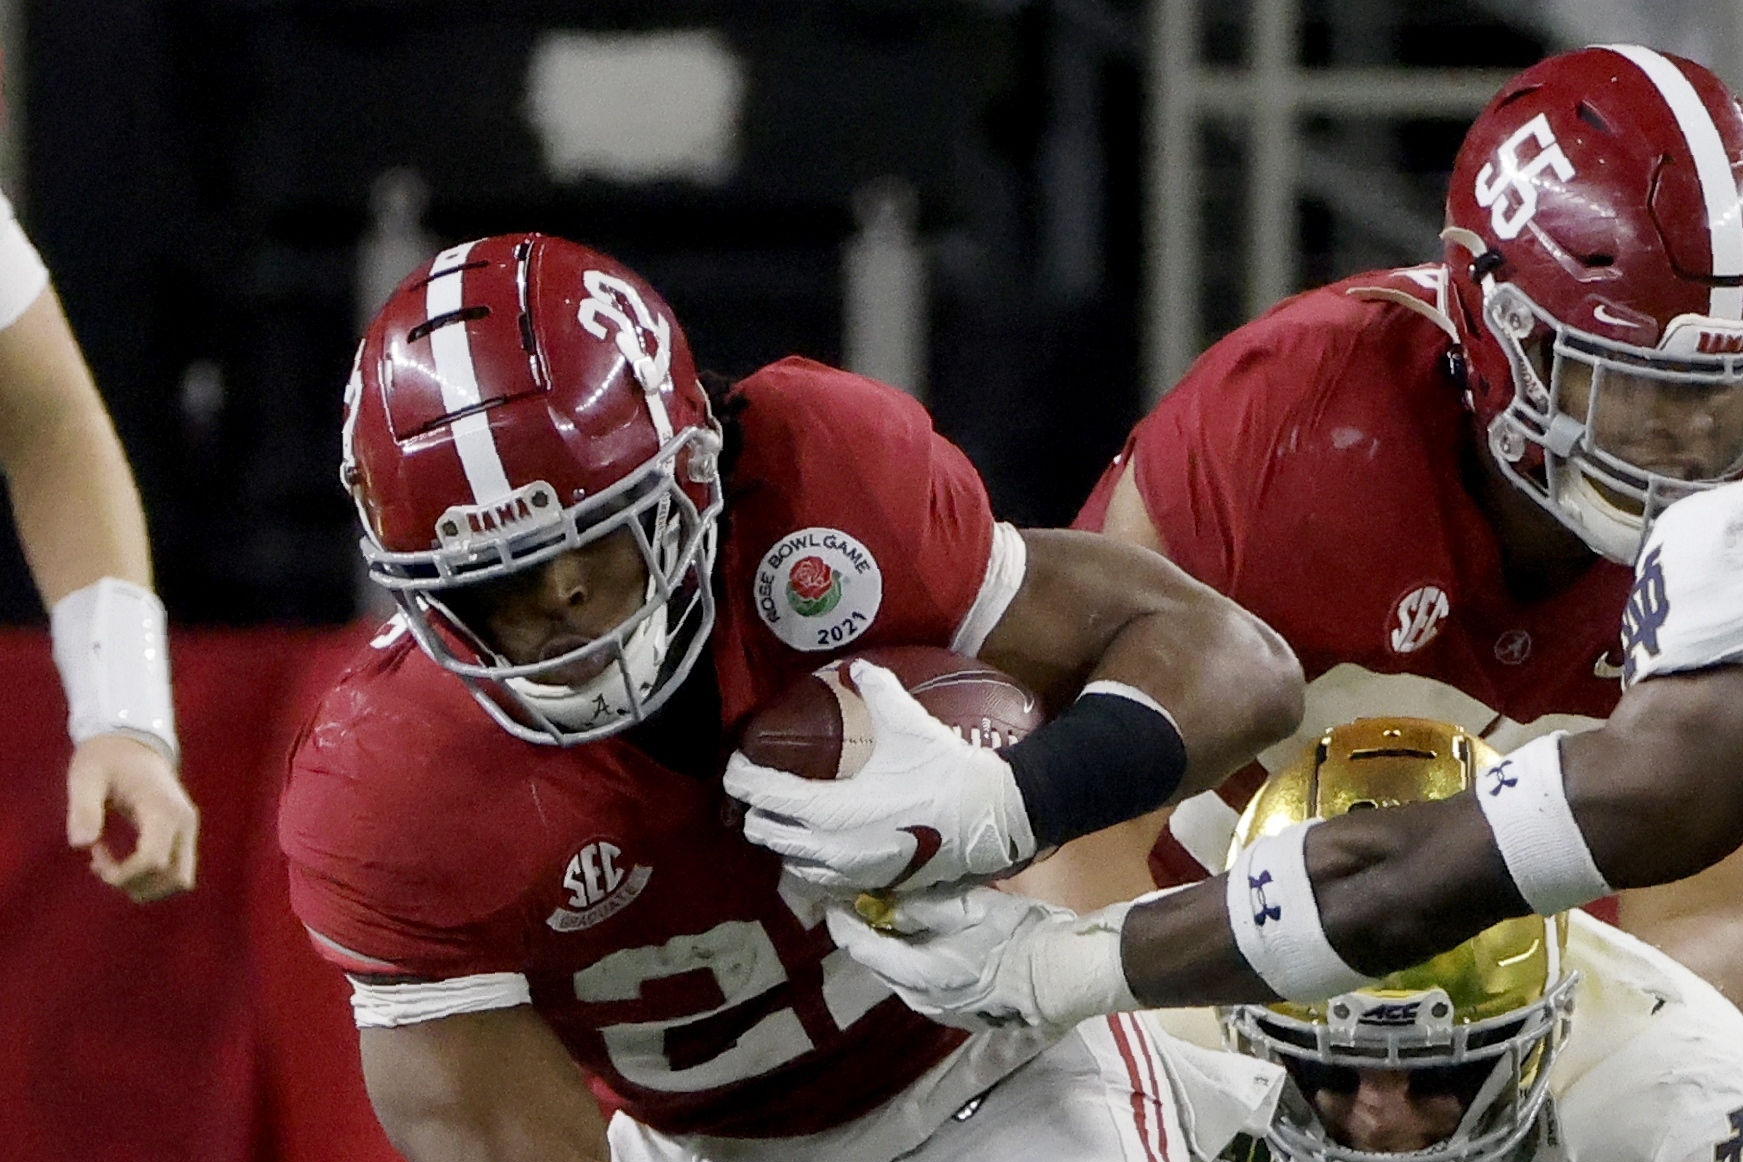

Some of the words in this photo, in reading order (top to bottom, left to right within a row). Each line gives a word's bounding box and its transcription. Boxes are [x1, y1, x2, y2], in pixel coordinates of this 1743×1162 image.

[1474, 111, 1577, 240] 55
[466, 496, 532, 533] BAMA
[768, 533, 820, 569] BOWL
[823, 534, 871, 575] GAME
[759, 571, 781, 623] ROSE
[817, 610, 868, 645] 2021
[563, 841, 625, 908] SEC
